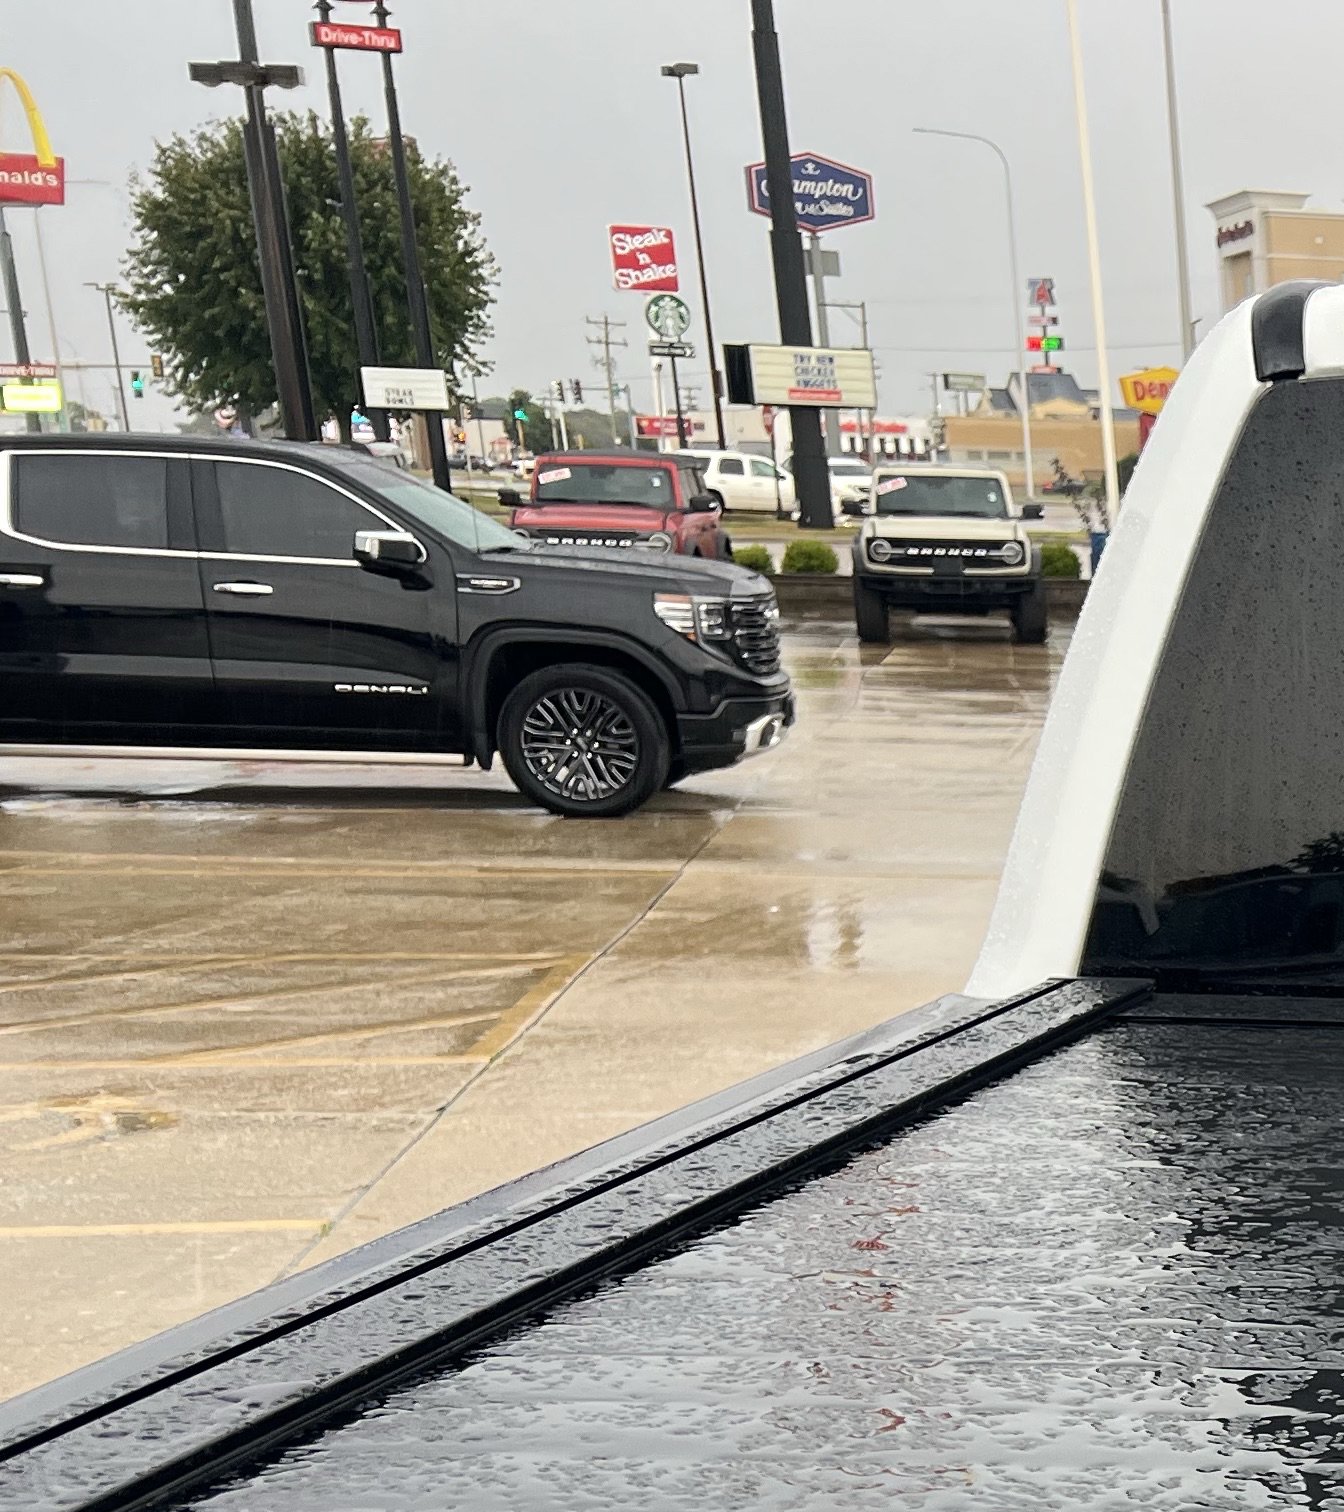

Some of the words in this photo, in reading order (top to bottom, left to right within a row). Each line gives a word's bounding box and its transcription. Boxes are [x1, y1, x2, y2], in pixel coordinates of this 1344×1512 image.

[320, 26, 396, 48] Drive-Thru
[612, 228, 671, 255] Steak
[615, 263, 677, 288] Shake
[546, 537, 633, 547] BRONCO
[334, 684, 429, 695] DENALI
